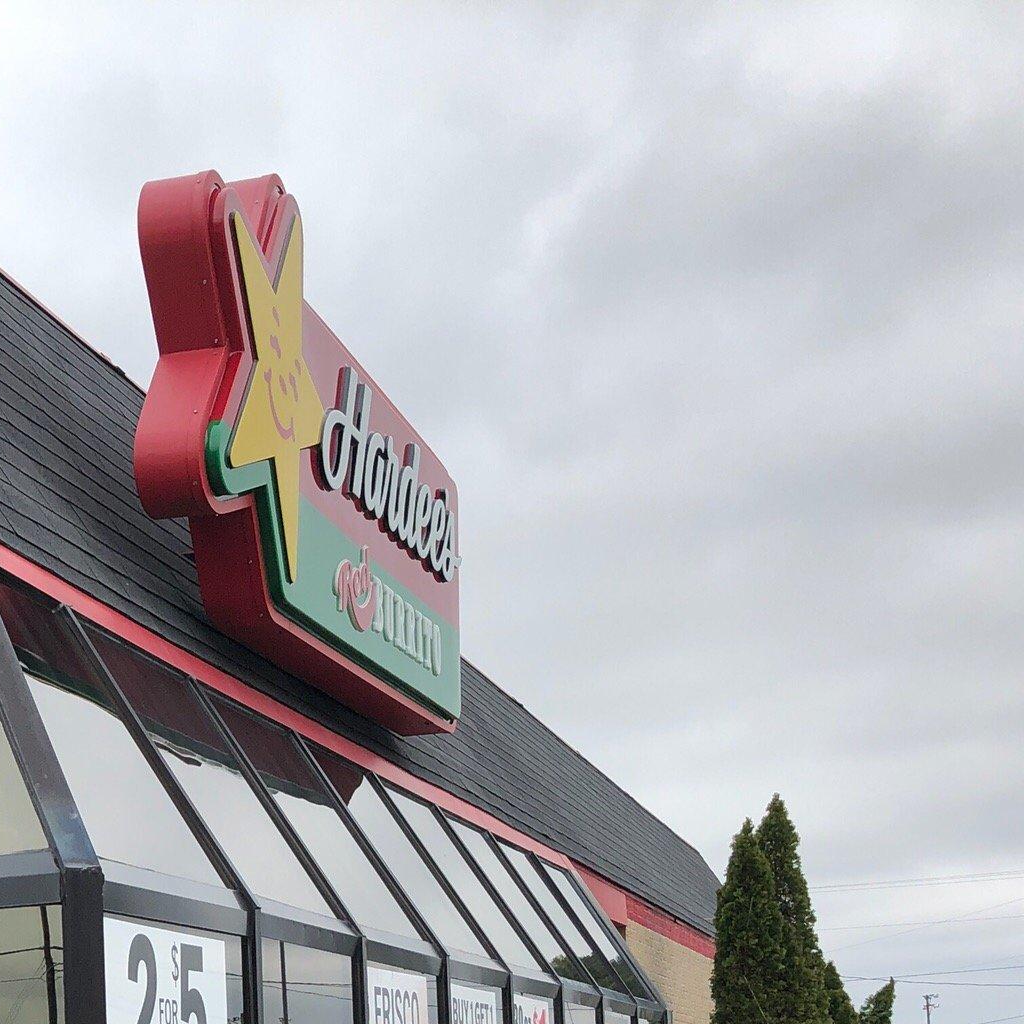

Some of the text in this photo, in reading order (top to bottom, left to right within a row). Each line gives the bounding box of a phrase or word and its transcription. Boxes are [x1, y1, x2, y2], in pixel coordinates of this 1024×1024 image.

[321, 365, 462, 582] Hardee's
[332, 545, 442, 677] Red BURRITO
